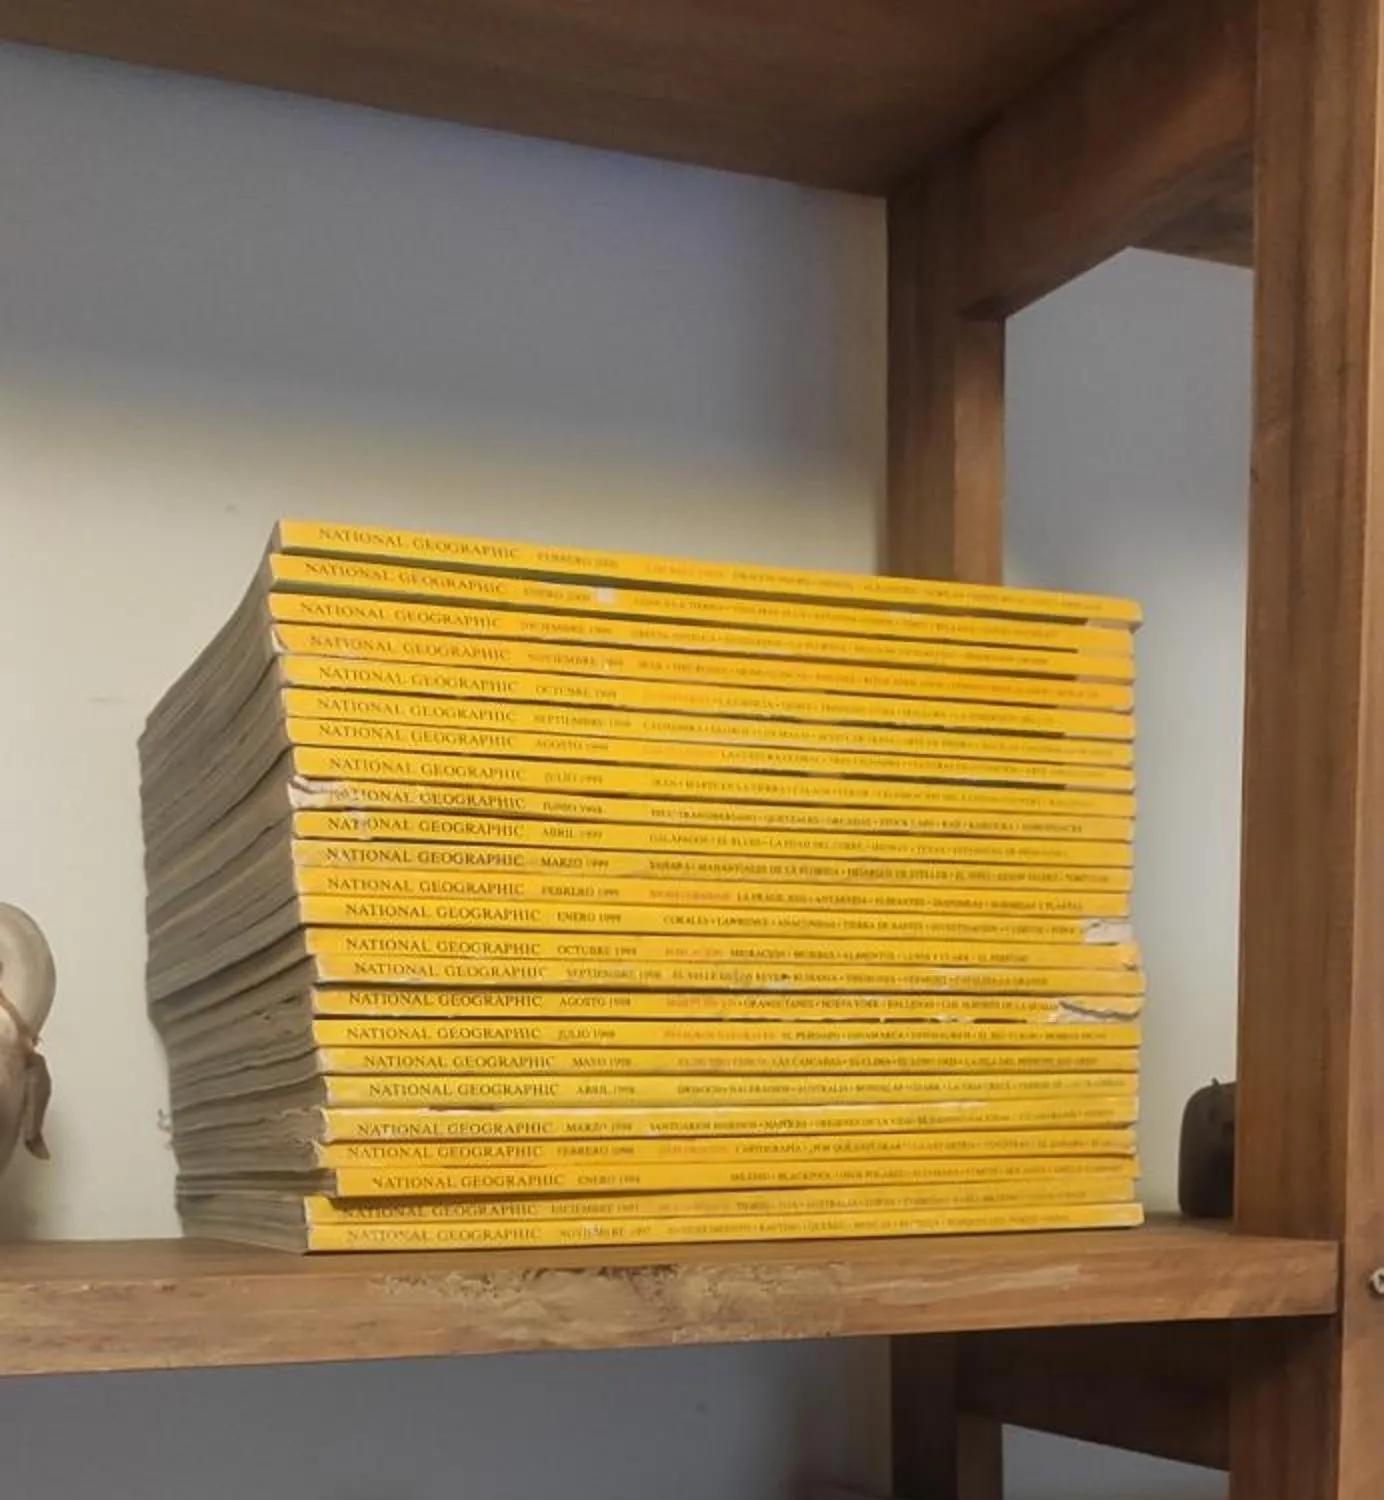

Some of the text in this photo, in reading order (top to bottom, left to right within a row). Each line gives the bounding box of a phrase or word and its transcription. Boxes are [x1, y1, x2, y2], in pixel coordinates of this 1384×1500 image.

[319, 527, 404, 547] NATIONAL
[412, 538, 519, 560] GEOGRAPHIC
[305, 563, 388, 582] NATIONAL
[399, 571, 507, 595] GEOGRAPHIC
[302, 602, 384, 620] NATIONAL
[395, 609, 502, 628] GEOGRAPHIC
[310, 634, 393, 652] NATIONAL
[403, 640, 511, 661] GEOGRAPHIC
[319, 666, 402, 685] NATIONAL
[412, 674, 519, 693] GEOGRAPHIC
[536, 683, 593, 698] OCTUBRE
[317, 698, 401, 716] NATIONAL
[410, 704, 517, 723] GEOGRAPHIC
[319, 724, 403, 740] NATIONAL
[411, 730, 517, 749] GEOGRAPHIC
[330, 757, 411, 774] NATIONAL
[420, 763, 527, 780] GEOGRAPHIC
[330, 787, 411, 805] ATIONAL
[419, 791, 526, 810] GEOGRAPHIC
[419, 819, 525, 837] GEOGRAPHIC
[542, 827, 575, 840] ABRIL
[326, 847, 411, 864] NATIONAL
[418, 851, 525, 867] GEOGRAPHIC
[540, 857, 581, 870] MARZO
[328, 876, 411, 892] NATIONAL
[419, 880, 525, 896] GEOGRAPHIC
[541, 884, 592, 897] FEBRERO
[345, 904, 621, 924] NATIONAL GEOGRAPHIC ENERO 1999
[346, 938, 428, 952] NATIONAL
[436, 939, 540, 956] GEOGRAPHIC
[557, 944, 610, 956] OCTUBRE
[354, 962, 636, 981] NATIONAL GEOGRAPHIC SEPTIEMBRE
[350, 991, 606, 1008] NATIONAL GEOGRAPHIC AGOSTO
[347, 1027, 430, 1040] NATIONAL
[437, 1027, 540, 1040] GEOGRAPHIC
[558, 1029, 591, 1041] JULIO
[364, 1055, 447, 1068] NATIONAL
[453, 1055, 555, 1068] GEOGRAPHIC
[573, 1056, 607, 1067] MAYO
[370, 1084, 452, 1096] NATIONAL
[458, 1084, 560, 1096] GEOGRAPHIC
[577, 1085, 611, 1096] ABRIL
[358, 1123, 441, 1137] NATIONAL
[448, 1122, 553, 1136] GEOGRAPHIC
[566, 1122, 606, 1134] MARZO
[347, 1145, 608, 1159] NATIONAL GEOGRAPHIC FEBRERO
[373, 1175, 457, 1189] NATIONAL
[461, 1174, 565, 1188] GEOGRAPHIC
[579, 1174, 615, 1185] ENERO
[344, 1205, 430, 1219] NATIONAL
[434, 1204, 538, 1218] GEOGRAPHIC
[347, 1229, 430, 1243] NATIONAL
[437, 1228, 541, 1242] GEOGRAPHIC
